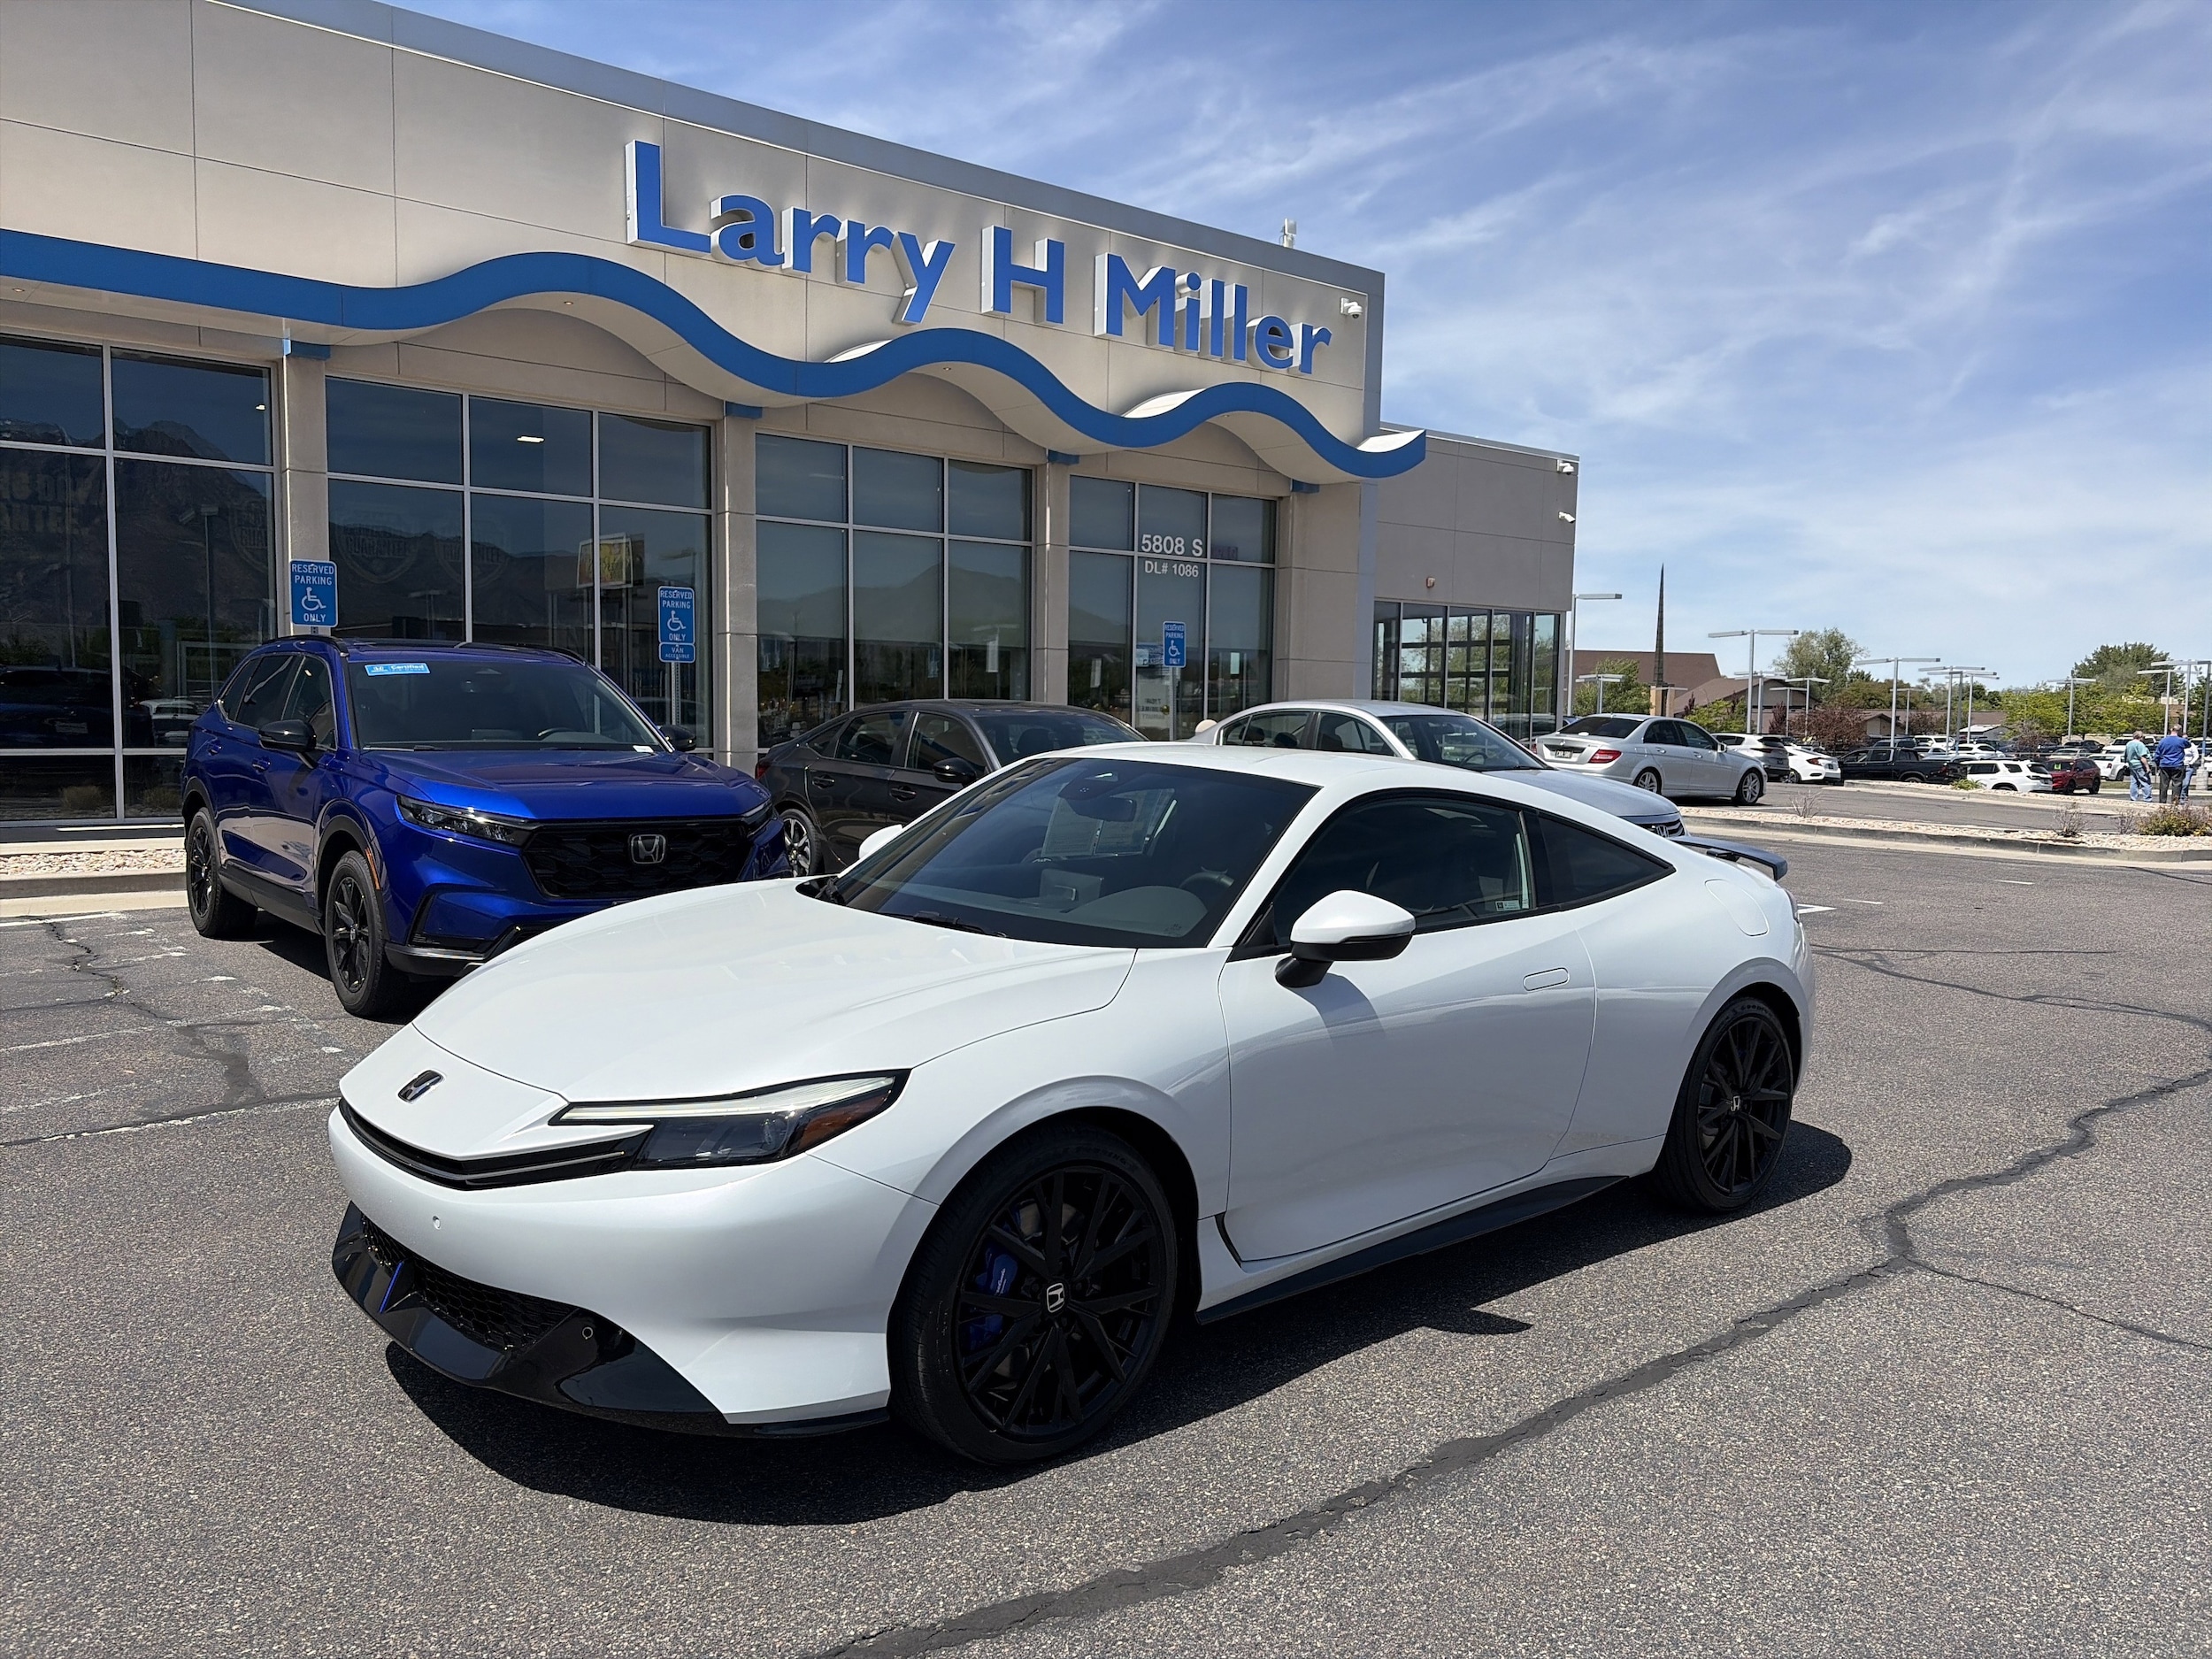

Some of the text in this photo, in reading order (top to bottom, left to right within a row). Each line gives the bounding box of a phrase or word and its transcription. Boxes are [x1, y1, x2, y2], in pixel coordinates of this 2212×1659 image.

[626, 140, 1333, 374] Larry H Miller
[1141, 534, 1185, 555] 5808
[1192, 538, 1203, 557] S
[291, 563, 334, 575] RESERVED
[1145, 560, 1199, 577] DL# 1086
[295, 575, 333, 586] PARKING
[660, 589, 693, 600] RESERVED
[662, 600, 691, 610] PARKING
[303, 612, 326, 623] ONLY
[668, 633, 687, 641] ONLY
